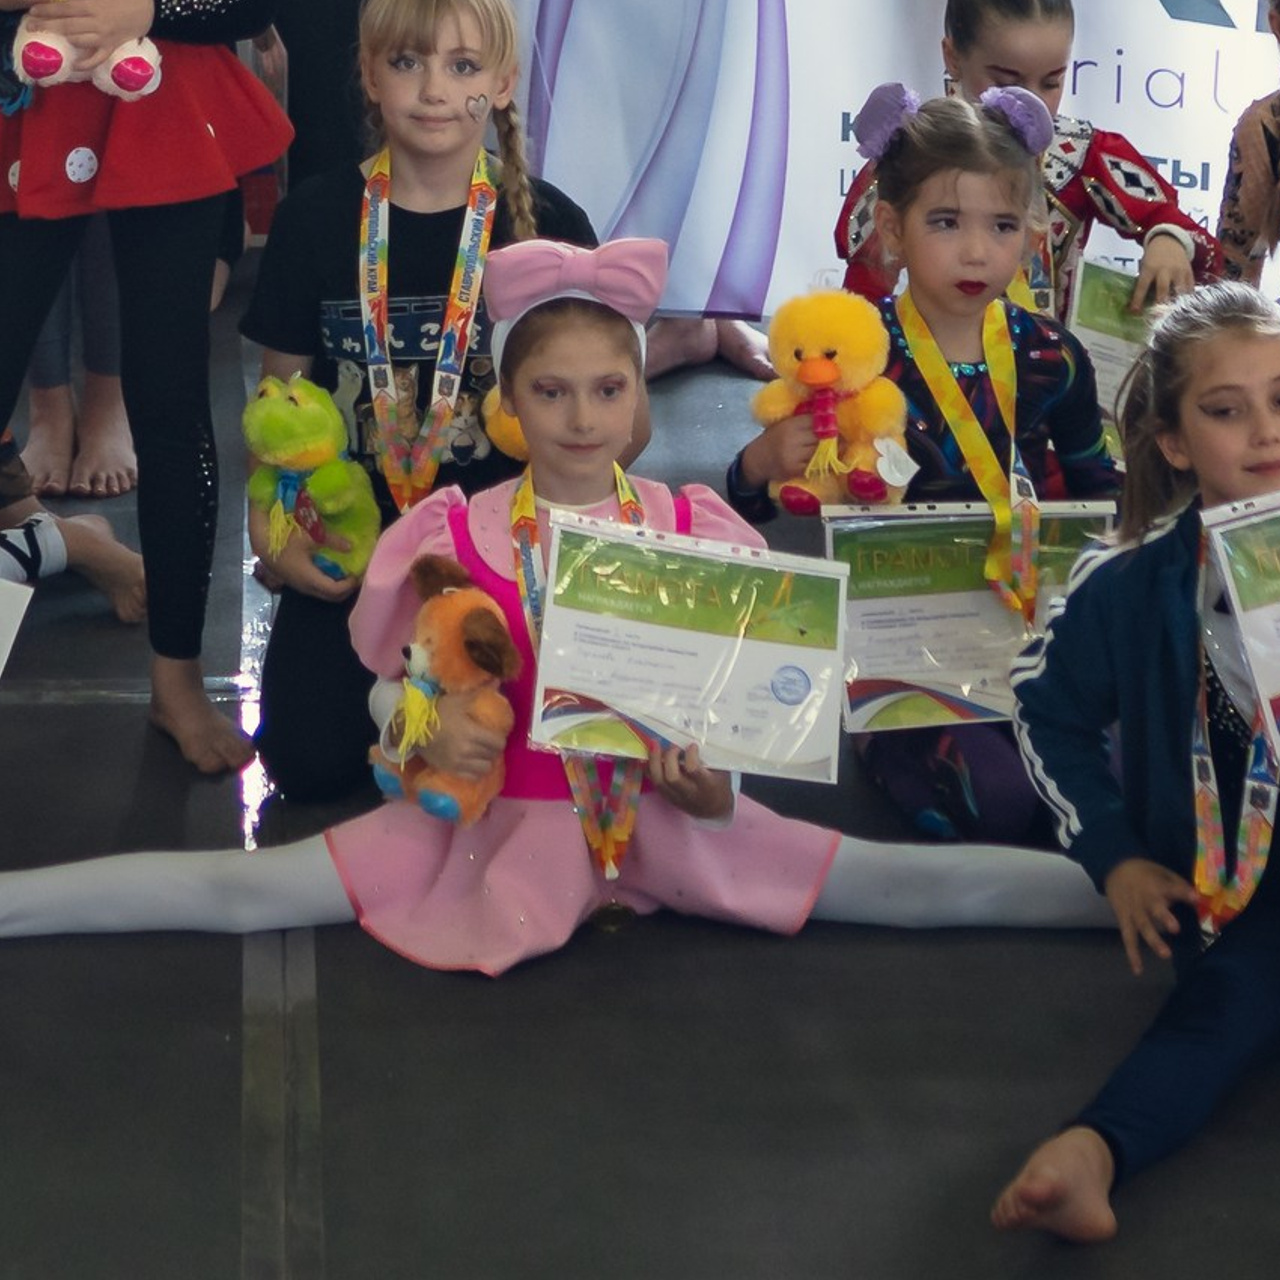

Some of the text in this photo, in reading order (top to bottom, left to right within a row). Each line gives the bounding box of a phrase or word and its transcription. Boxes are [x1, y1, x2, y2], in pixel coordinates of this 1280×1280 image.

[1071, 48, 1229, 114] rial
[367, 268, 378, 294] КРАЙ
[458, 218, 485, 303] СТАВРОПОЛЬСКИЙ
[857, 546, 972, 573] ГРАМОТ
